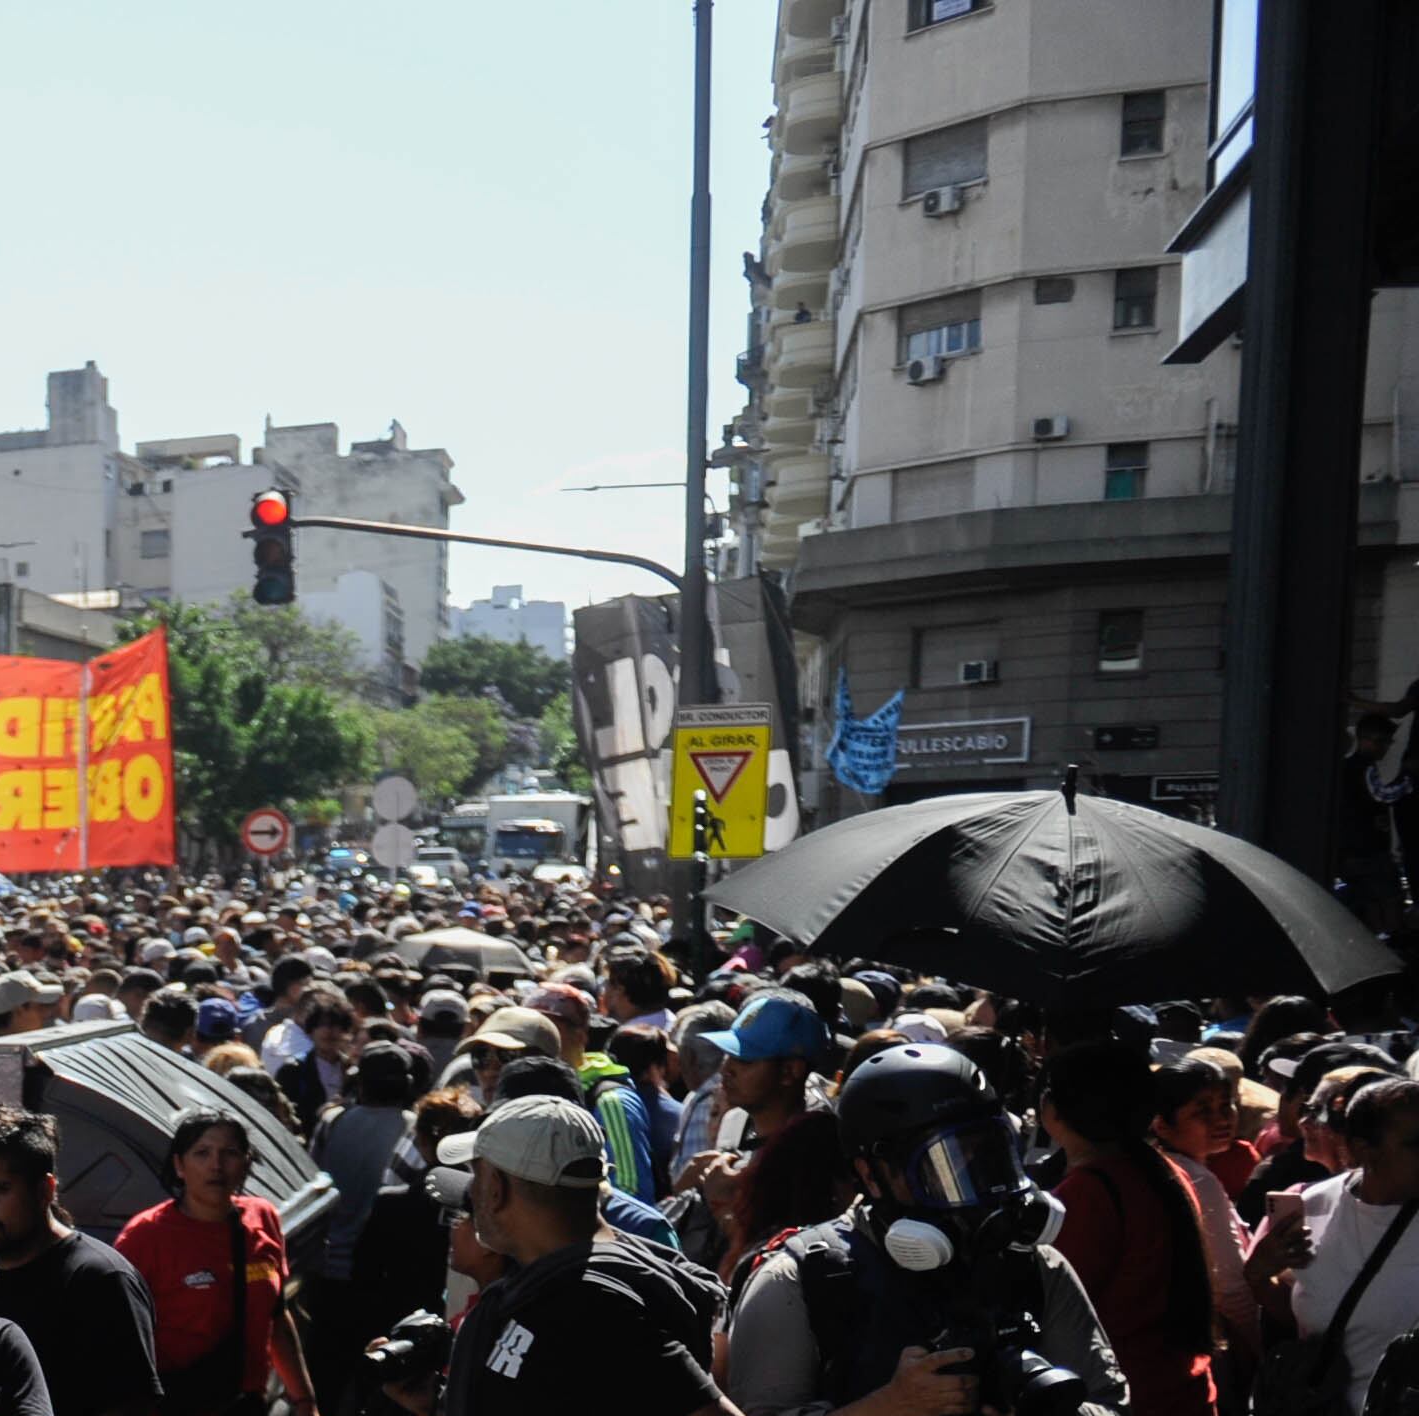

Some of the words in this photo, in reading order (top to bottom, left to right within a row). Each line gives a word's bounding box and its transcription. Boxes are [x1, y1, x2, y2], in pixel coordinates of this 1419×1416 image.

[699, 711, 768, 722] CONDUCTOR
[690, 736, 705, 747] AL
[896, 734, 1008, 755] ULLESCABIO
